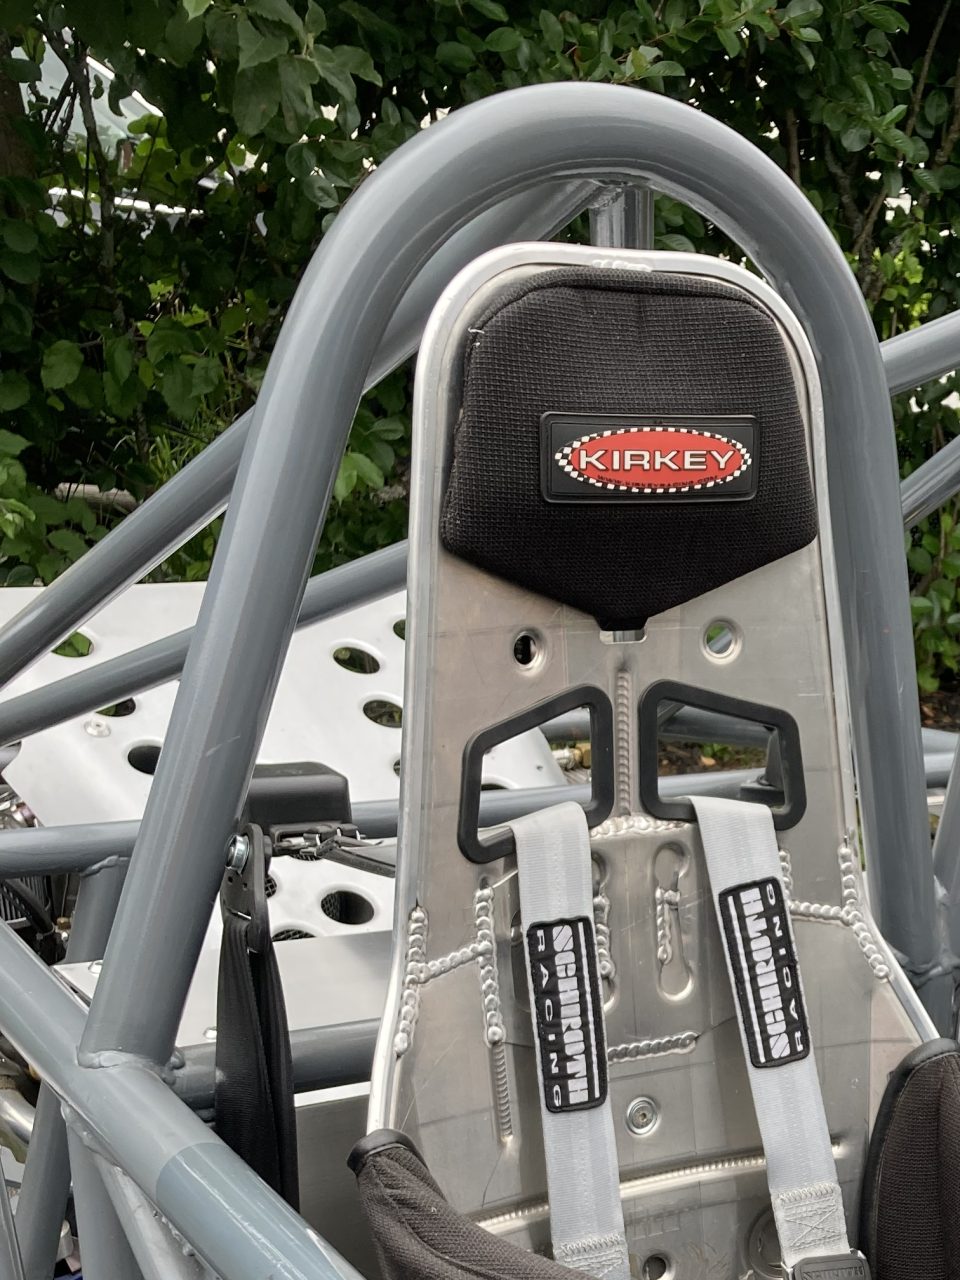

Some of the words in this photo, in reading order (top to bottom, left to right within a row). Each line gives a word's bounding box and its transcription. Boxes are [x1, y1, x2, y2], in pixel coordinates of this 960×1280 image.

[578, 450, 735, 471] KIRKEY
[536, 929, 562, 1107] RACING
[552, 924, 589, 1105] SCHROTH
[740, 887, 790, 1059] SCHROTH
[766, 883, 804, 1052] RACING
